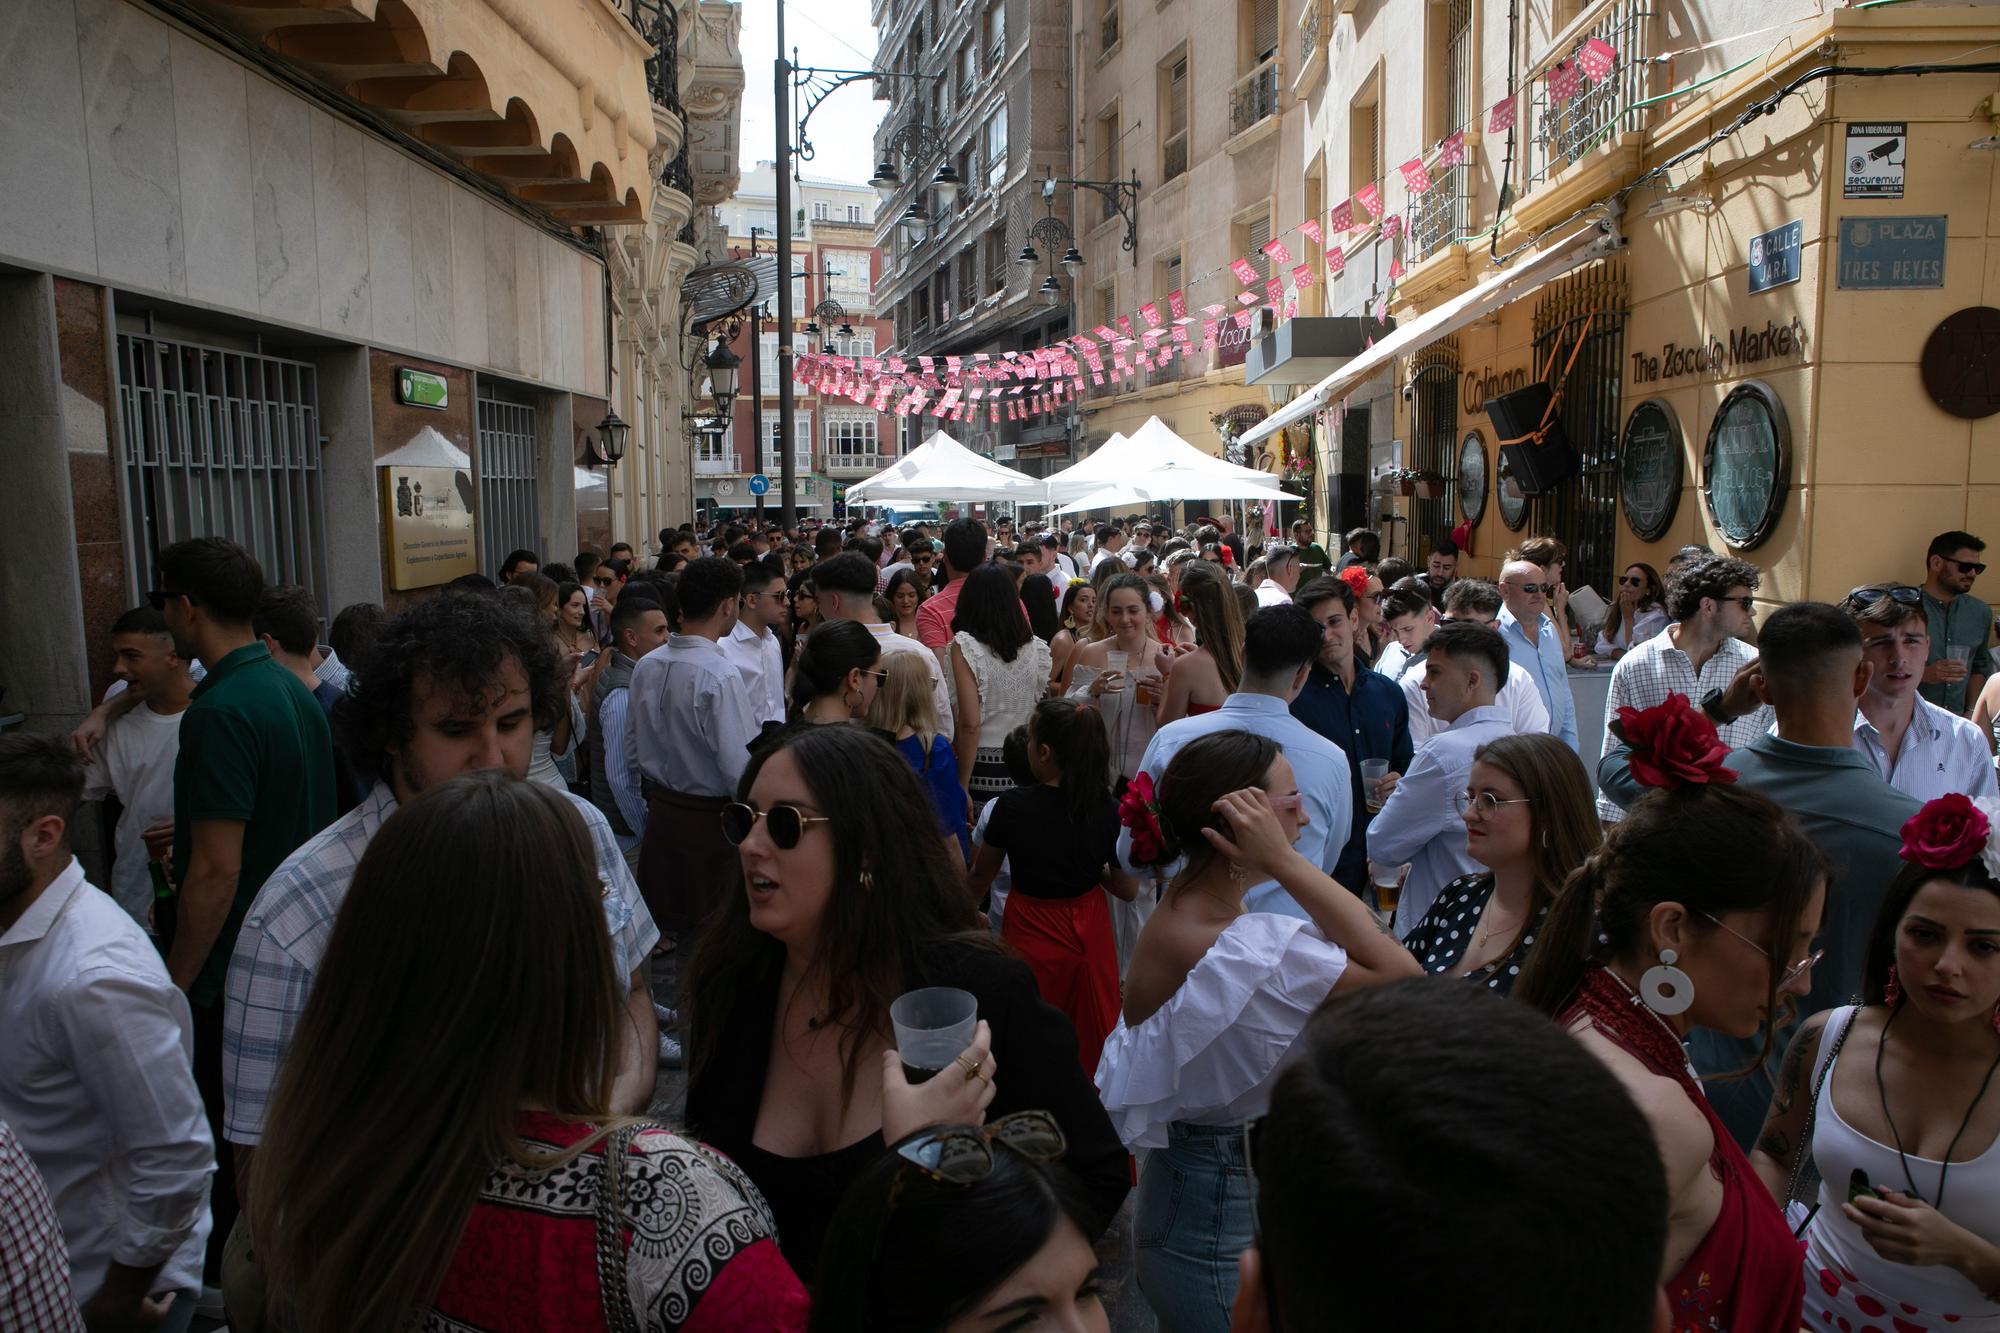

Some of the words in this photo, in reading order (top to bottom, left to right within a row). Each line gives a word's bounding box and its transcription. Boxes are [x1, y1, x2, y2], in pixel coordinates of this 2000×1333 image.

[1850, 126, 1865, 135] ZONA
[1865, 125, 1902, 135] VIDEOVIGILADA
[1848, 176, 1902, 185] securemur
[1766, 227, 1800, 256] CALLE
[1879, 223, 1936, 240] PLAZA
[1760, 262, 1788, 283] JARA
[1843, 261, 1880, 281] TRES
[1892, 260, 1940, 281] REYES
[1631, 351, 1658, 385] The
[1662, 334, 1725, 380] Zocalo
[1729, 315, 1799, 367] Market
